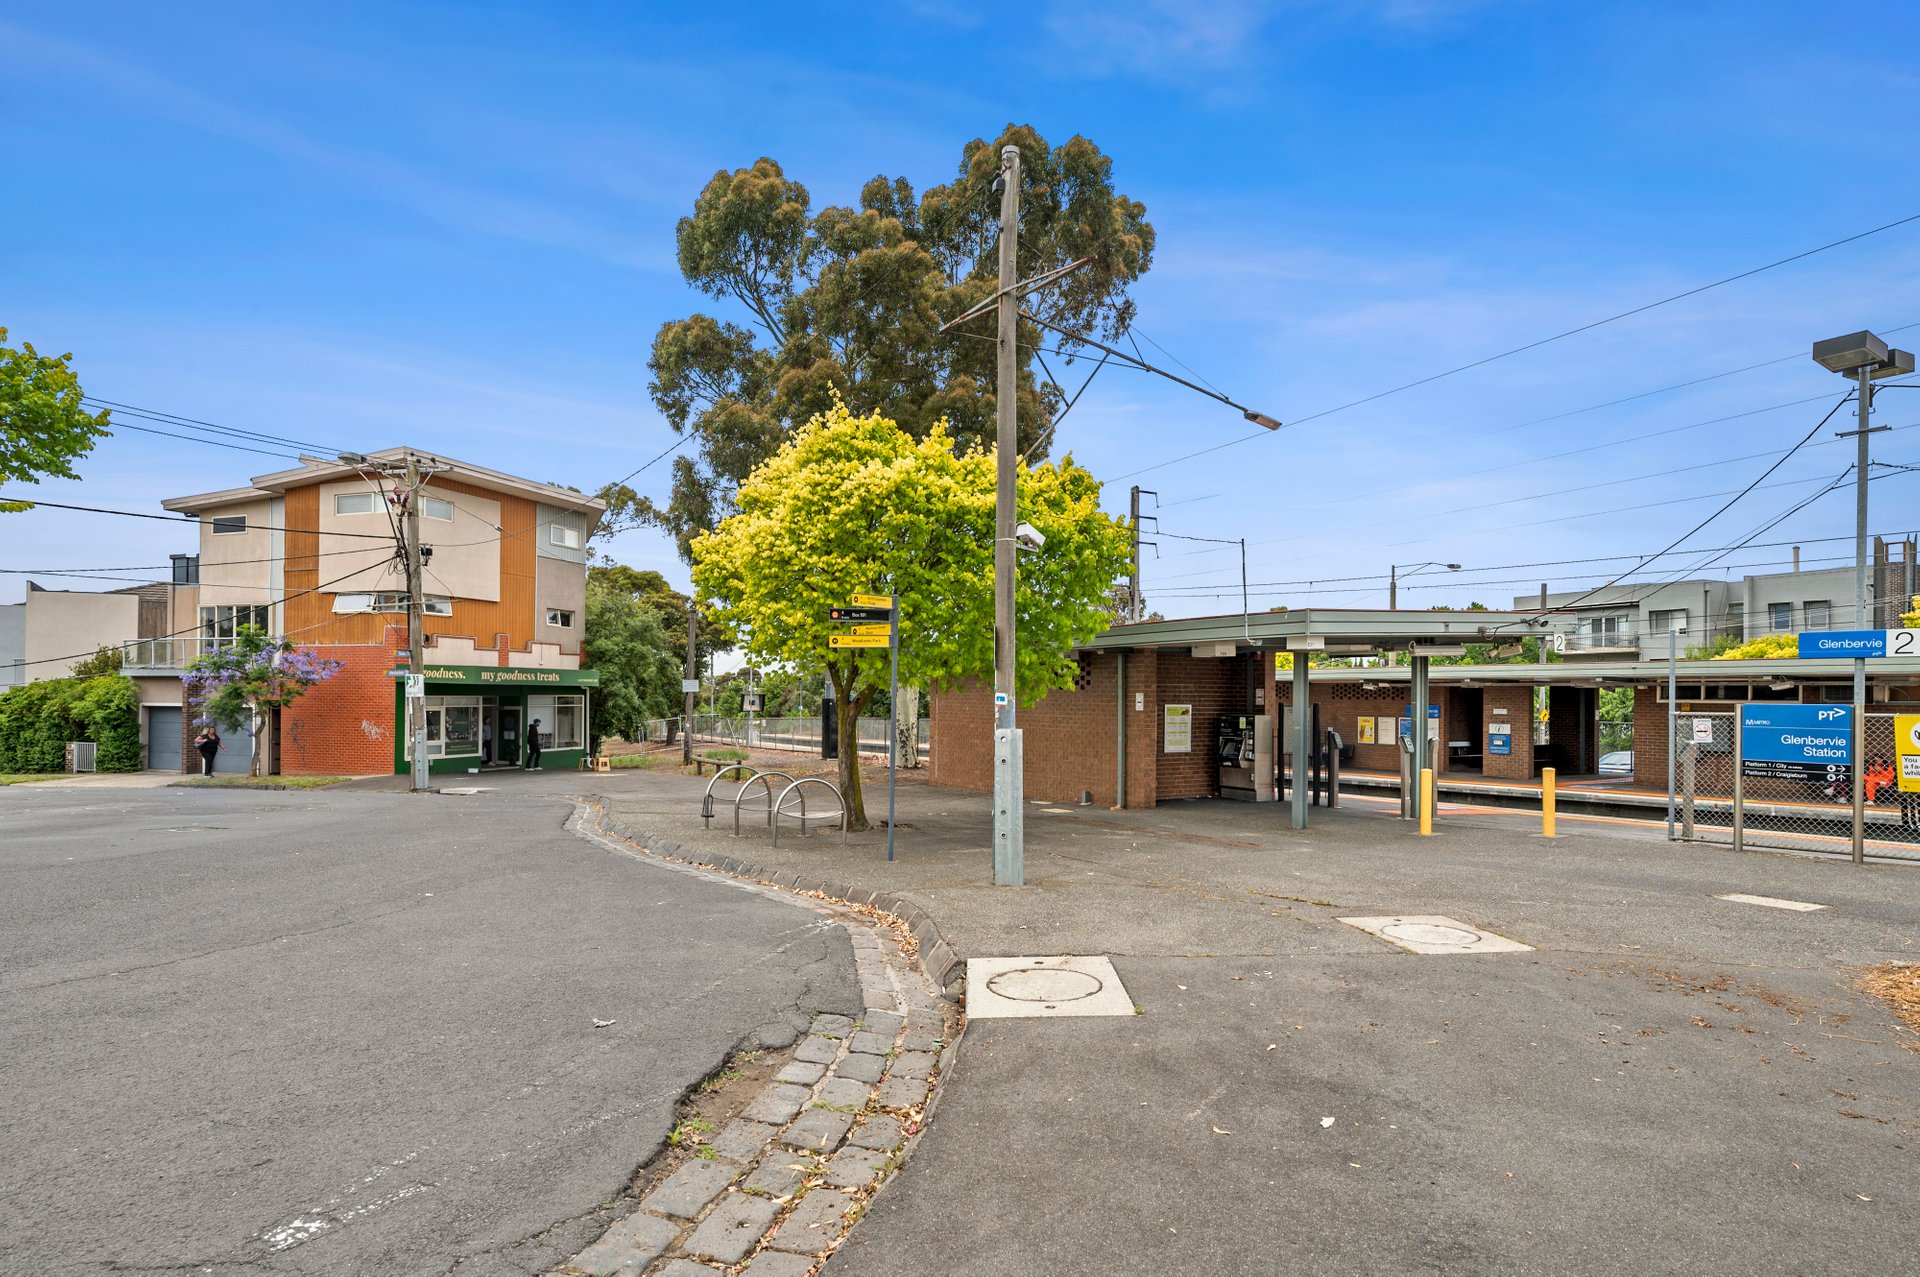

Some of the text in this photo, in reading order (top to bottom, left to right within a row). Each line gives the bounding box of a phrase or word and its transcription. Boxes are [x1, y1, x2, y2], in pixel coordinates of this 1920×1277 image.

[1556, 636, 1563, 651] 2
[1818, 638, 1882, 648] Glenbervie
[1895, 632, 1914, 654] 2
[481, 670, 560, 682] my goodness treats
[1781, 734, 1846, 746] Glenbervie
[1804, 747, 1846, 758] Station
